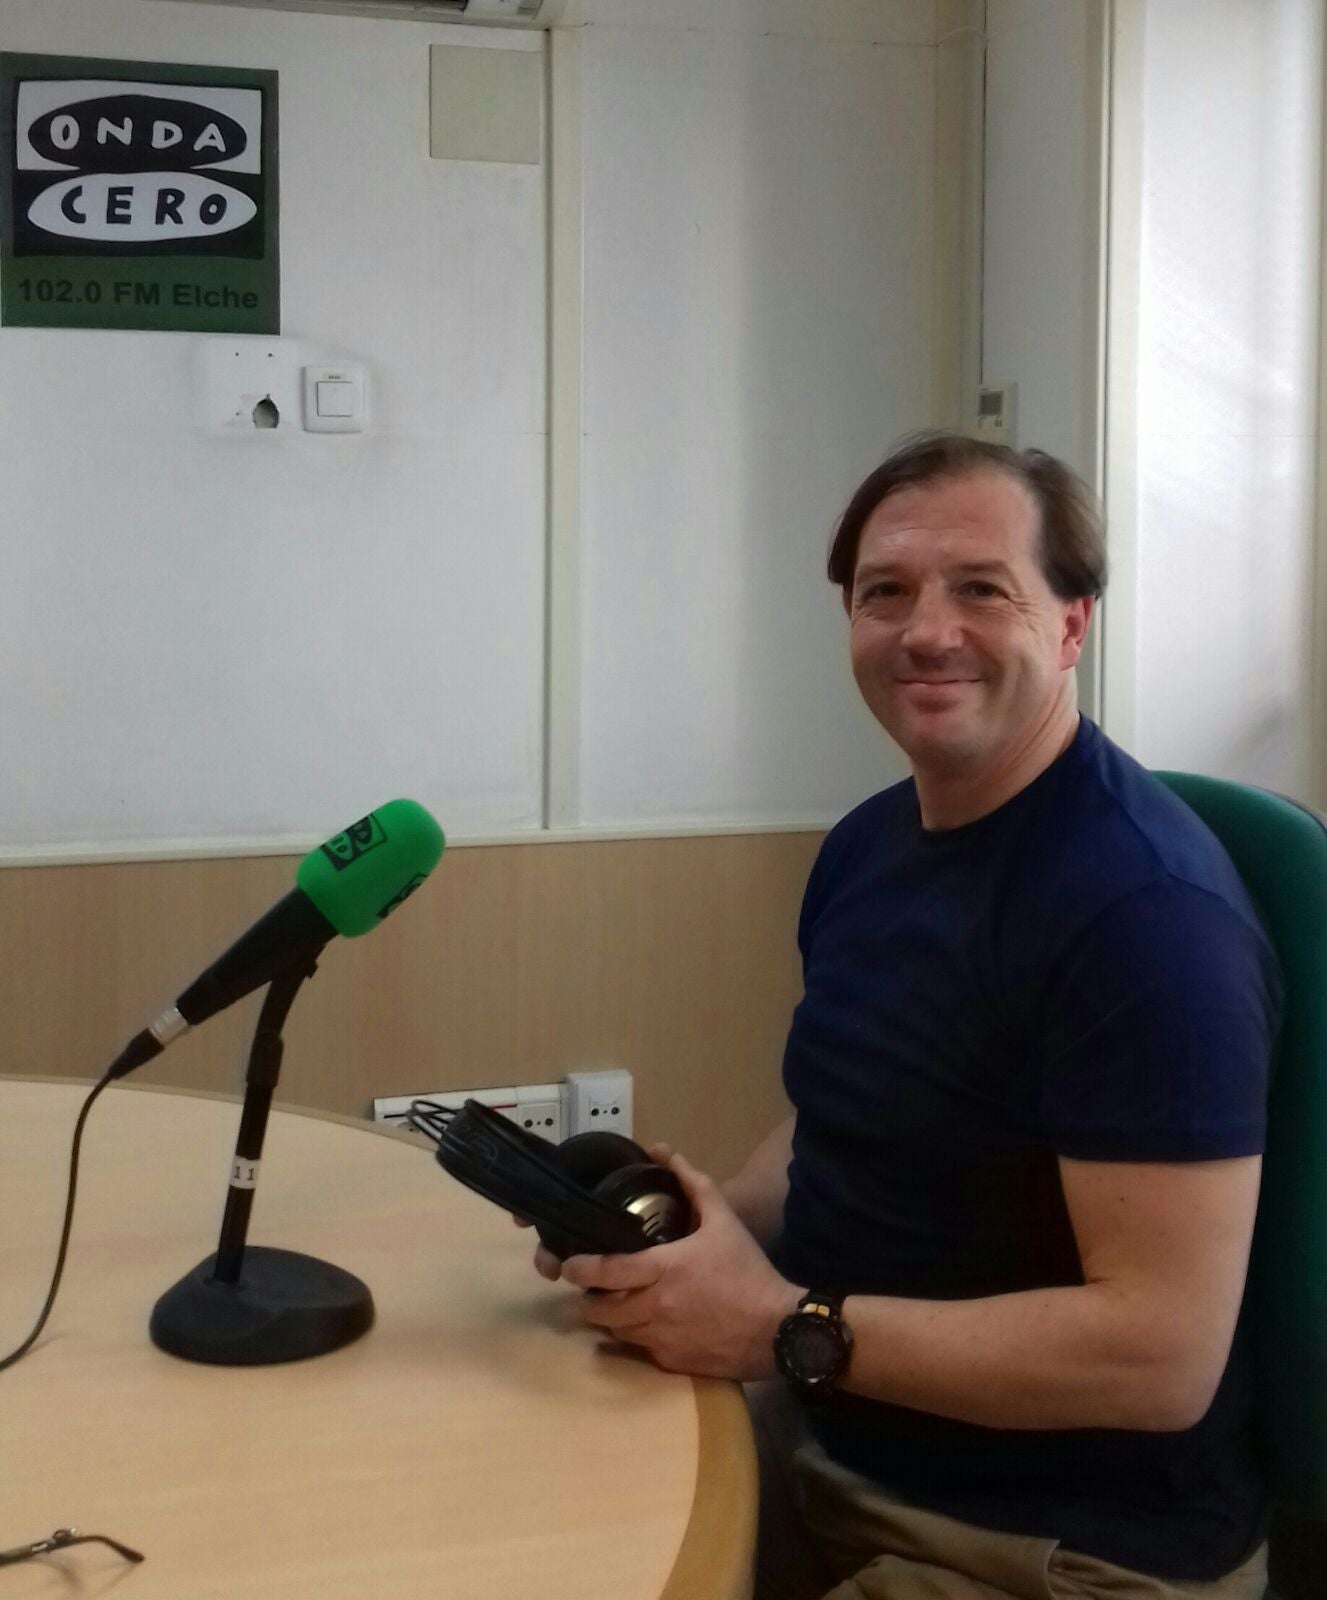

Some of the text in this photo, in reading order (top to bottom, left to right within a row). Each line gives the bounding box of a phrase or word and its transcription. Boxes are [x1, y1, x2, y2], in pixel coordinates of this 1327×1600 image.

[50, 114, 227, 153] ONDA
[60, 184, 228, 226] CERO
[18, 278, 258, 309] 102.0 FM Elche
